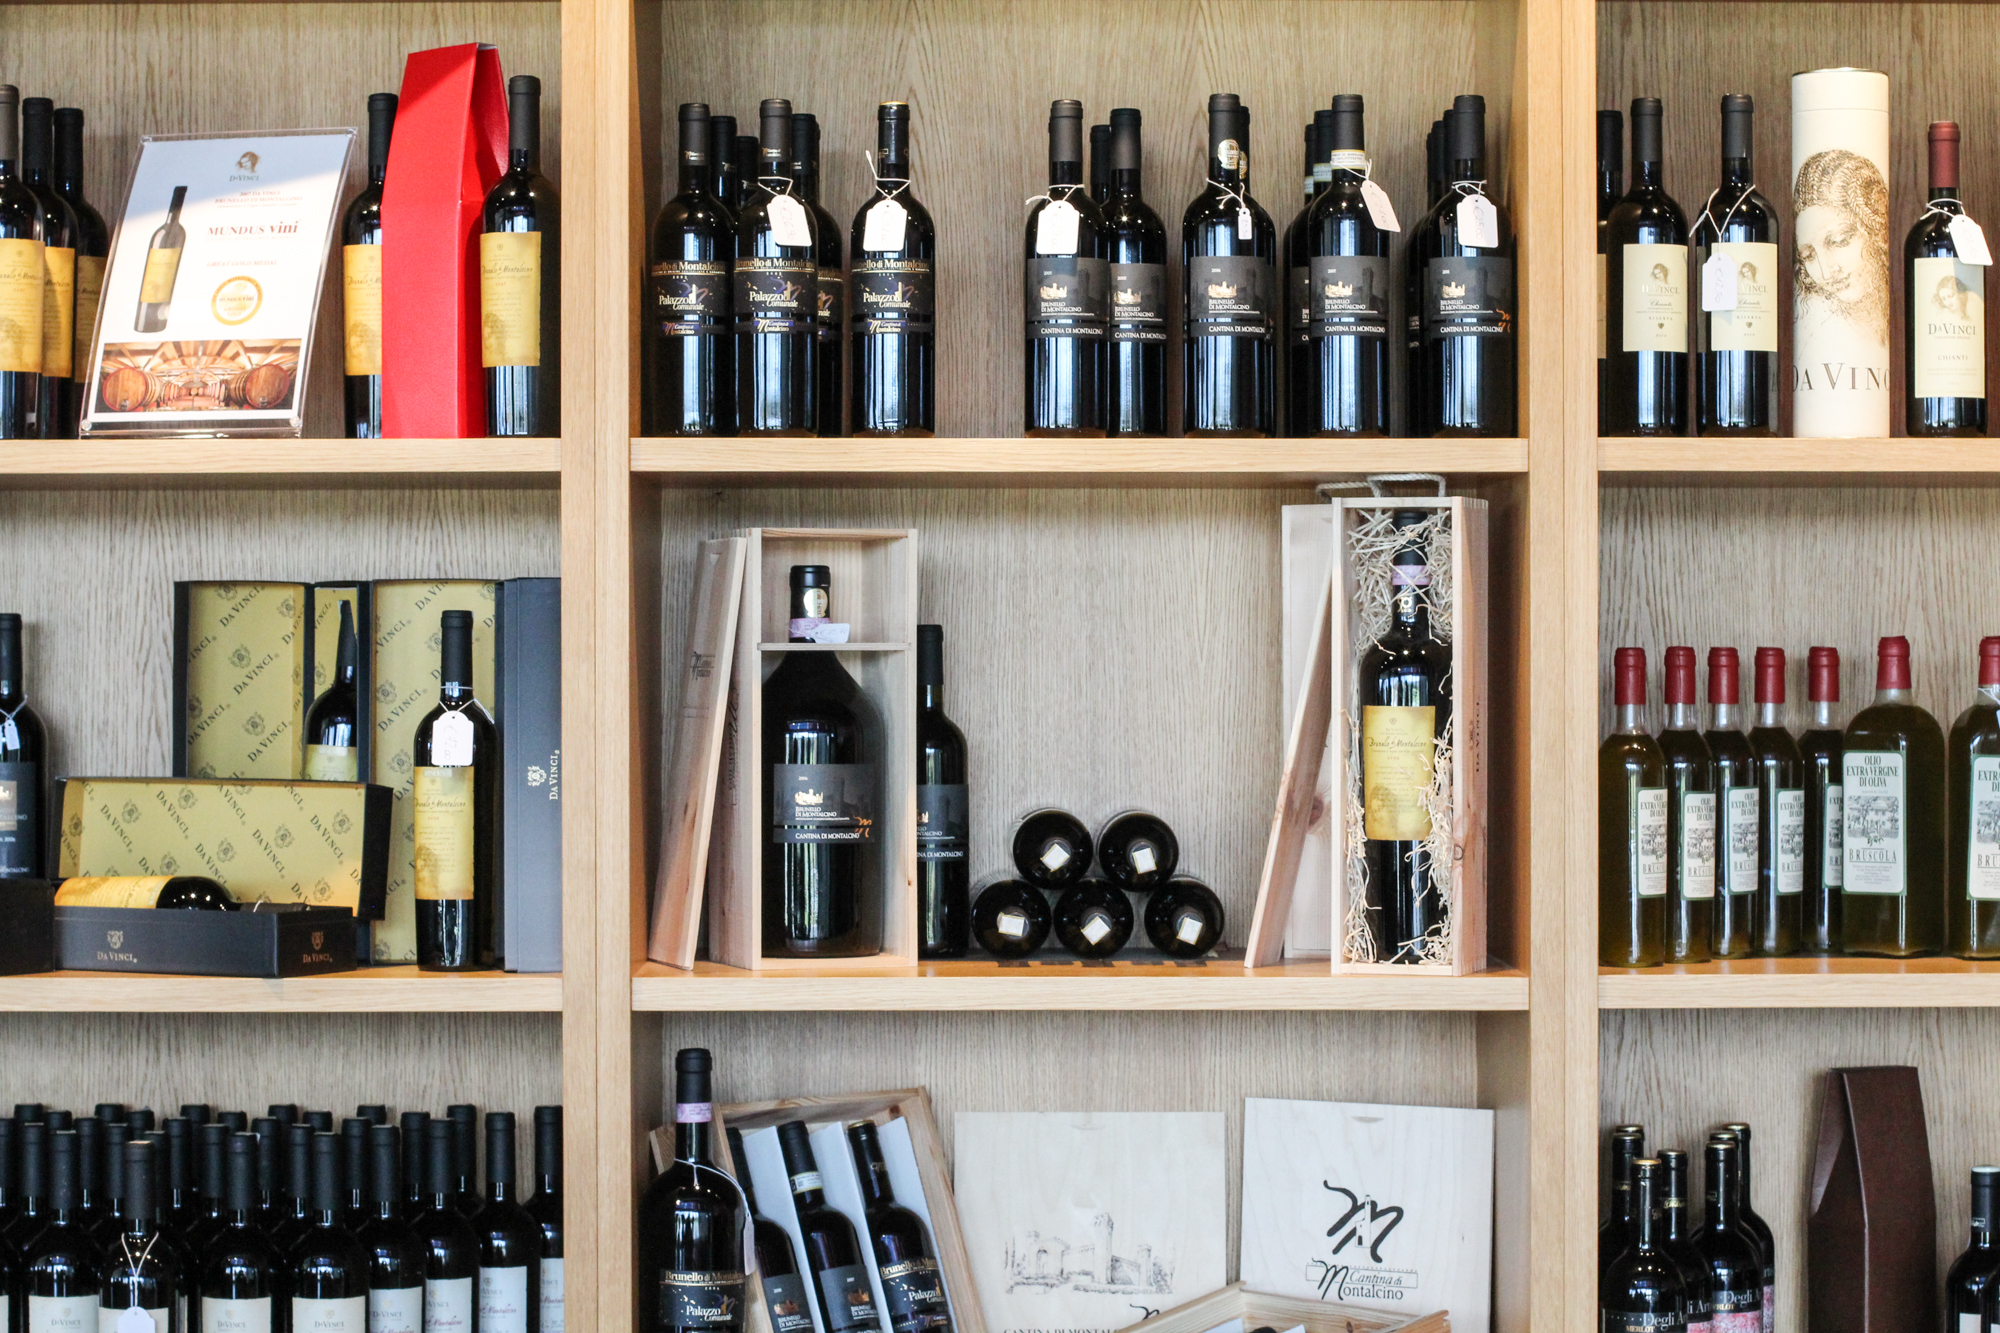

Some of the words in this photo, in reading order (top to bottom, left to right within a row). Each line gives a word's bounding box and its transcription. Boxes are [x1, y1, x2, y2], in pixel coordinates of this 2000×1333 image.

[206, 225, 265, 236] MUNDUS
[269, 220, 299, 234] vini
[773, 258, 815, 268] Montalcino
[884, 258, 930, 269] Montalcino
[659, 294, 689, 305] Palazzo
[749, 291, 785, 302] Palazzo
[863, 292, 897, 303] Palazzo
[672, 302, 705, 311] Comunale
[766, 299, 799, 308] Comunale
[878, 300, 911, 308] Comunale
[1114, 331, 1140, 339] CANTINA
[1937, 354, 1969, 362] CHIANTI
[218, 610, 235, 628] DA
[232, 586, 261, 615] VINCI
[414, 595, 431, 612] DA
[376, 620, 407, 649] VINCI
[232, 679, 249, 696] DA
[246, 653, 274, 682] VINCI
[377, 717, 395, 732] DA
[391, 689, 422, 717] VINCI
[197, 704, 226, 732] VINCI
[247, 747, 263, 763] DA
[260, 721, 288, 750] VINCI
[1366, 736, 1390, 748] Brunello
[1396, 735, 1427, 748] Montalcino
[1864, 755, 1882, 766] OLIO
[548, 754, 558, 785] VINCI
[1846, 765, 1870, 777] EXTRA
[1869, 765, 1899, 777] VERGINE
[1859, 777, 1867, 787] DI
[1867, 776, 1887, 788] OLIVA
[549, 786, 558, 800] DA
[224, 790, 246, 820] VINCI
[1640, 801, 1655, 810] EXTRA
[1686, 805, 1703, 813] EXTRA
[1731, 801, 1748, 809] EXTRA
[1780, 802, 1795, 811] EXTRA
[156, 790, 167, 806] DA
[166, 802, 190, 836] VINCI
[100, 804, 112, 822] DA
[110, 816, 133, 849] VINCI
[310, 814, 321, 832] DA
[320, 827, 344, 860] VINCI
[194, 843, 206, 860] DA
[252, 829, 263, 846] DA
[261, 841, 286, 874] VINCI
[1849, 848, 1897, 862] BRUSCOLA
[138, 857, 150, 873] DA
[97, 951, 109, 961] DA
[109, 951, 134, 962] VINCI
[302, 954, 312, 963] DA
[312, 953, 331, 963] VINCI
[880, 1260, 916, 1275] Brunello
[665, 1270, 704, 1282] Brunello
[1349, 1270, 1392, 1285] Cantina
[1393, 1276, 1402, 1286] di
[908, 1289, 938, 1301] Palazzo
[1723, 1290, 1753, 1308] Degli
[686, 1305, 721, 1316] Palazzo
[704, 1313, 733, 1322] Comunale
[778, 1314, 801, 1323] BRUNELLO
[1643, 1312, 1675, 1331] Degli
[1625, 1325, 1656, 1333] MERLOT
